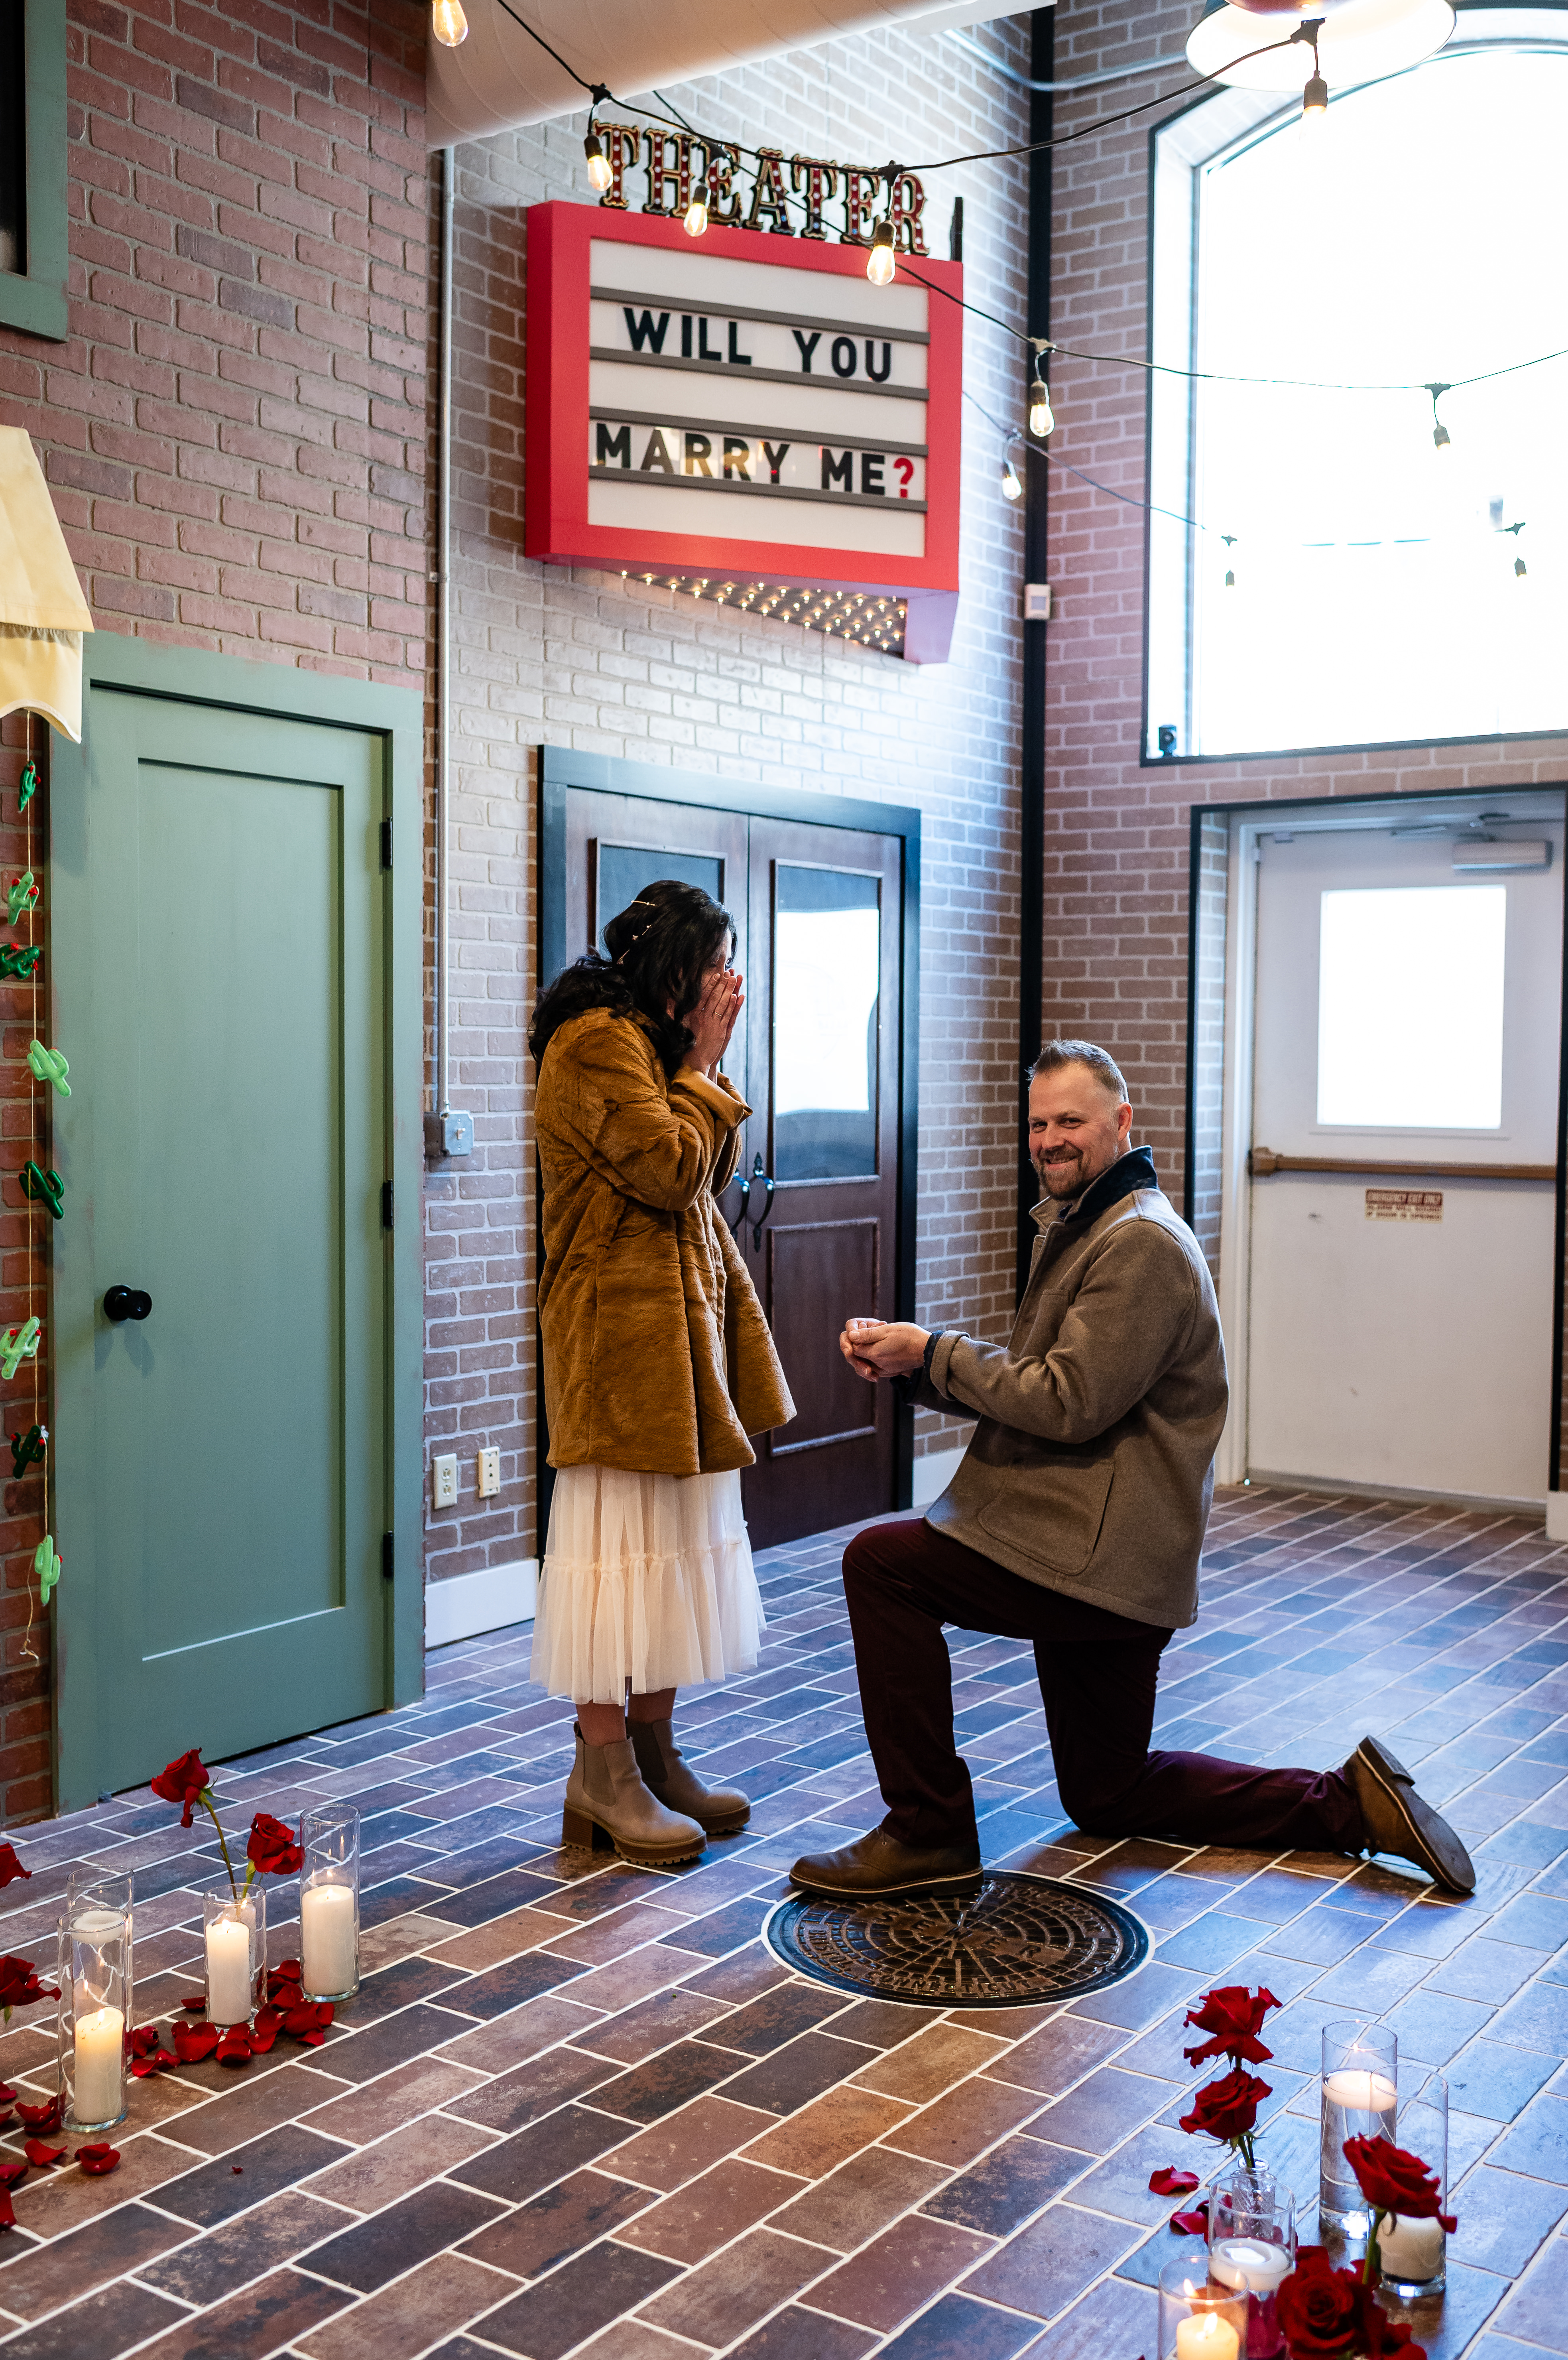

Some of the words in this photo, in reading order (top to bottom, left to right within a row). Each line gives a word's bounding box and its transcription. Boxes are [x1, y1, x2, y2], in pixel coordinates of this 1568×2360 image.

[594, 118, 929, 255] THEATER
[623, 307, 752, 365] WILL
[791, 329, 892, 384] YOU
[595, 422, 791, 485] MARRY
[821, 447, 915, 498] ME?
[874, 1910, 1042, 1960] SEWER
[867, 1970, 1031, 1994] CONNECTICUT
